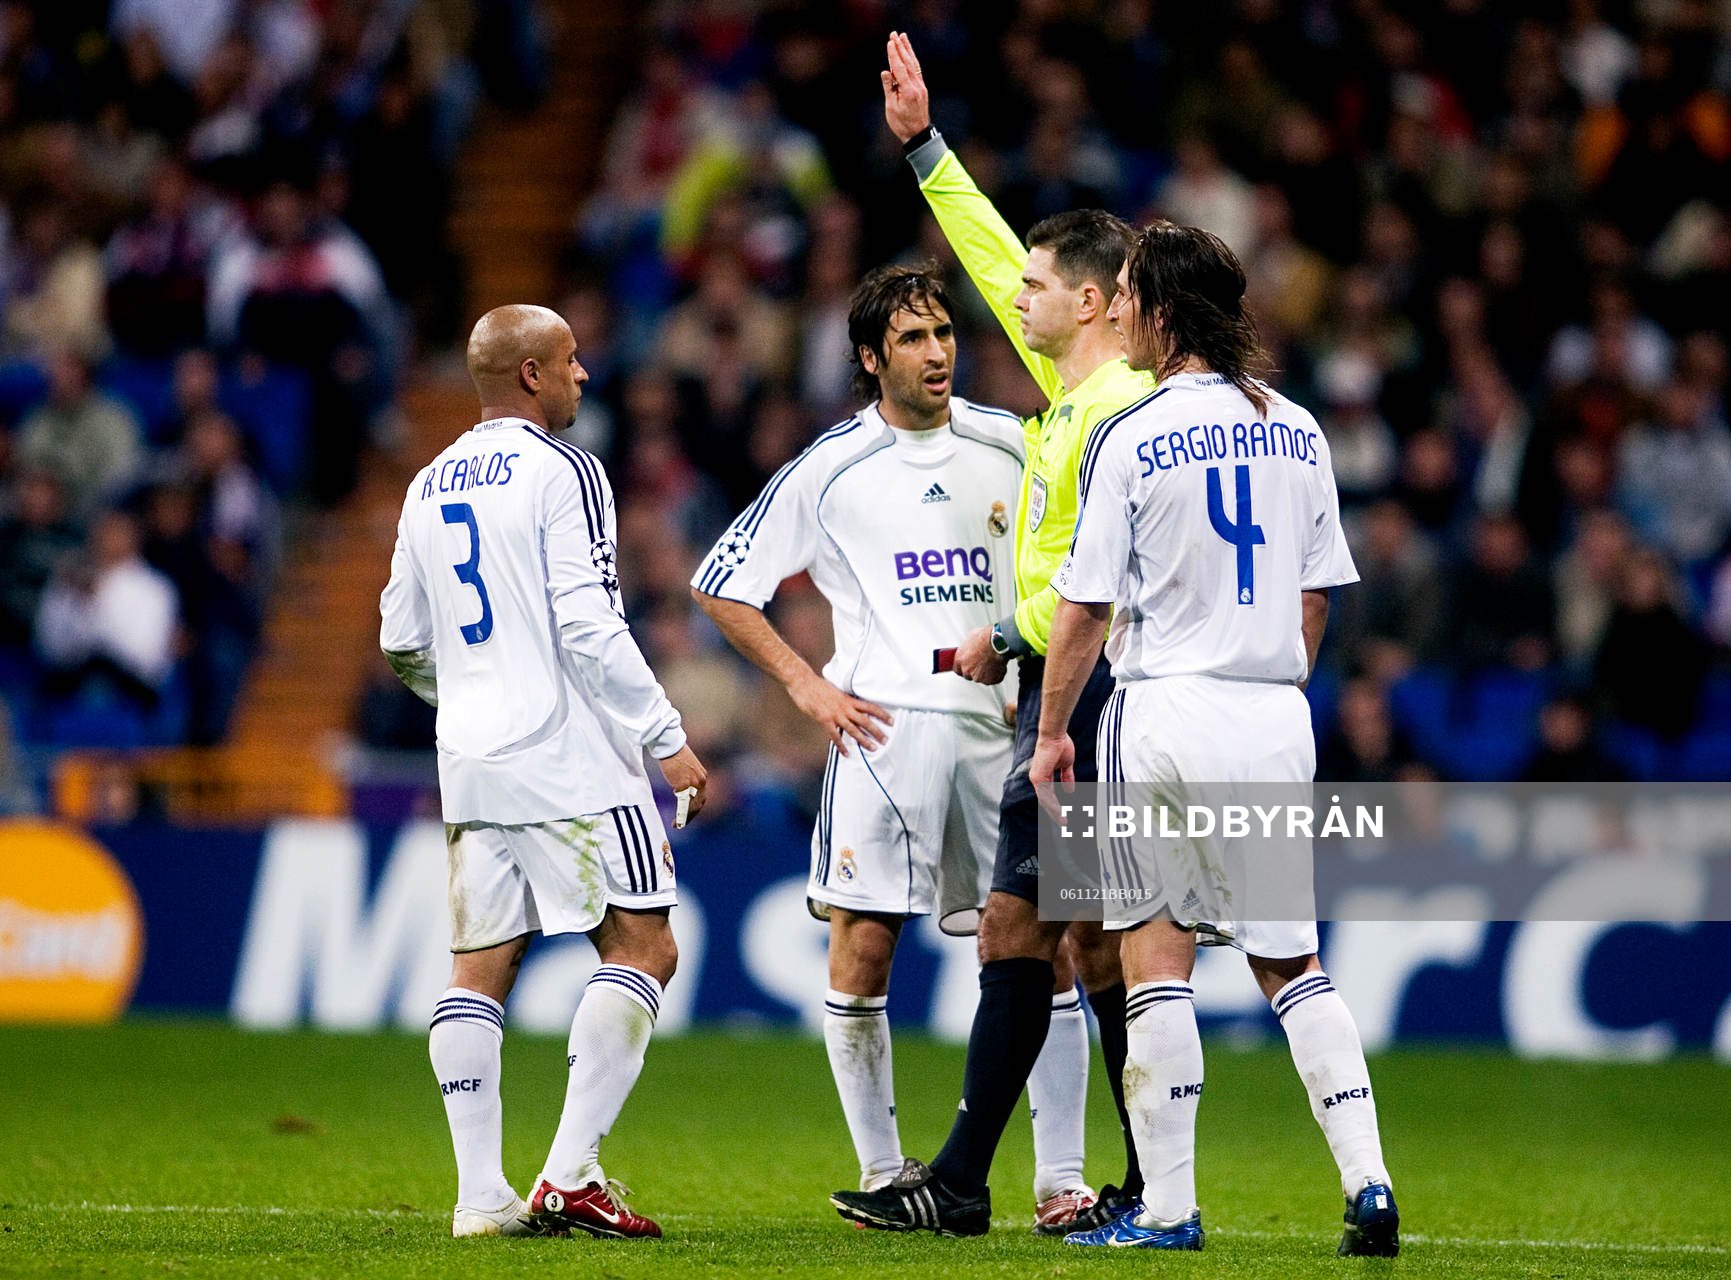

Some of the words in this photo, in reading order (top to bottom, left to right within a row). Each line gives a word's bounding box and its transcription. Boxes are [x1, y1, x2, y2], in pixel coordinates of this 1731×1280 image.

[1136, 424, 1227, 479] SERGIO
[1232, 421, 1317, 466] RAMOS
[921, 496, 951, 504] adidas
[1206, 464, 1267, 606] 4
[440, 502, 494, 646] 3
[894, 546, 993, 583] BenQ
[900, 584, 994, 606] SIEMENS
[441, 1079, 482, 1097] RMCF
[1323, 1087, 1370, 1110] RMCF
